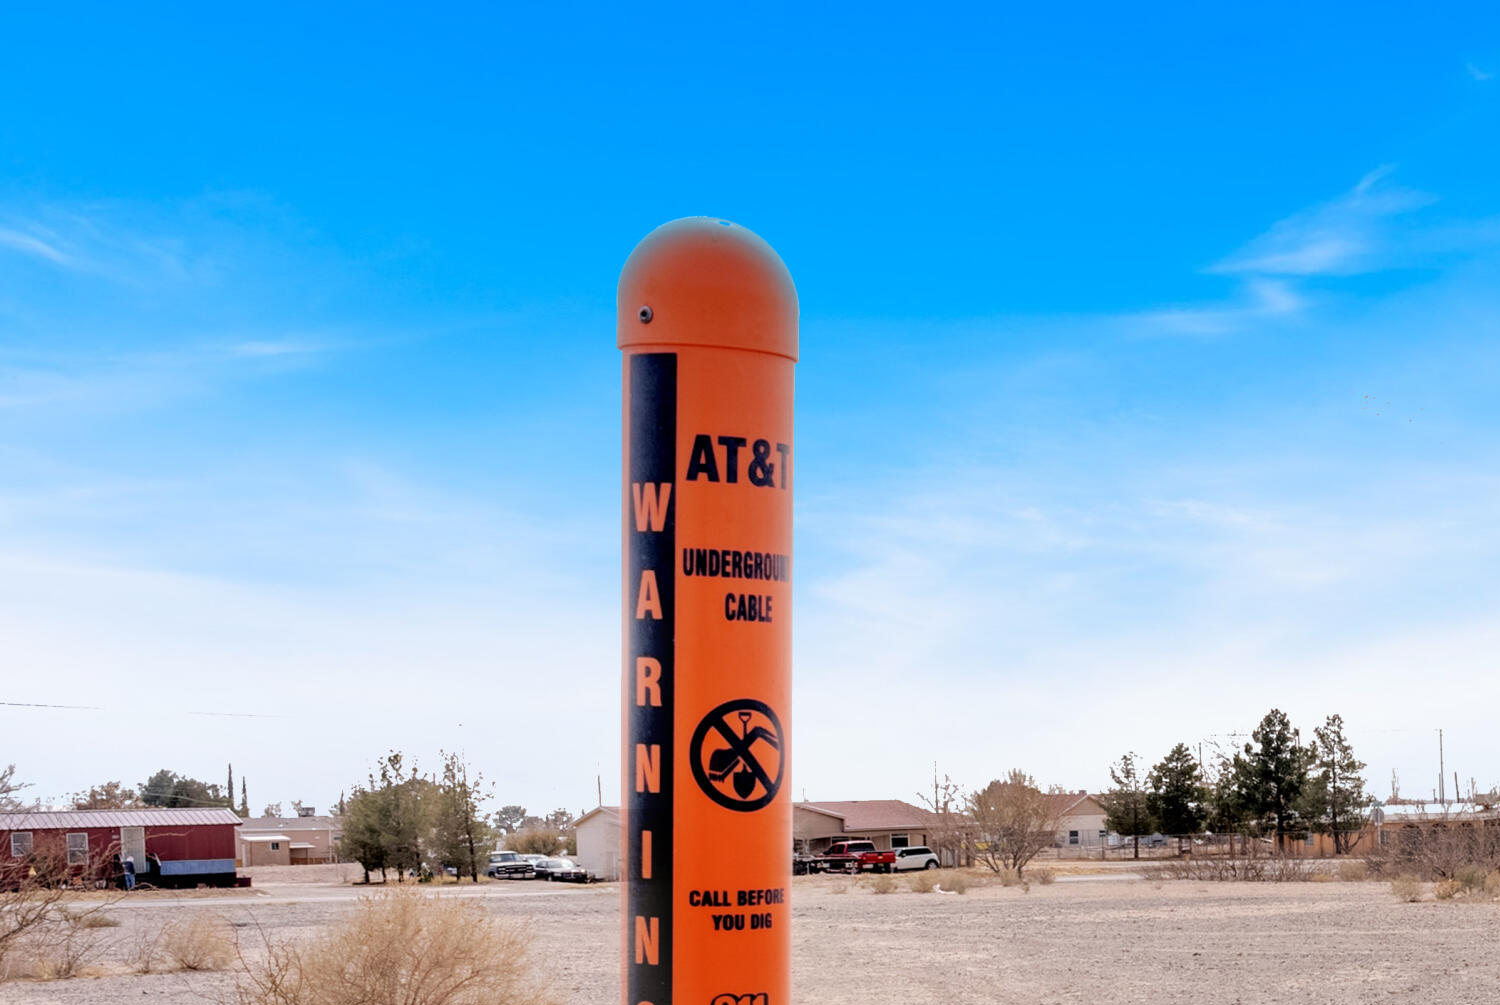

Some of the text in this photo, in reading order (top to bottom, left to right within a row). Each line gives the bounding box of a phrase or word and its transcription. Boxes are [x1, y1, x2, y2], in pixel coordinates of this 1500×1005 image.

[686, 433, 790, 490] AT&T
[724, 592, 773, 623] CABLE
[689, 888, 785, 907] CALL BEFORE
[712, 913, 772, 931] YOU DIG
